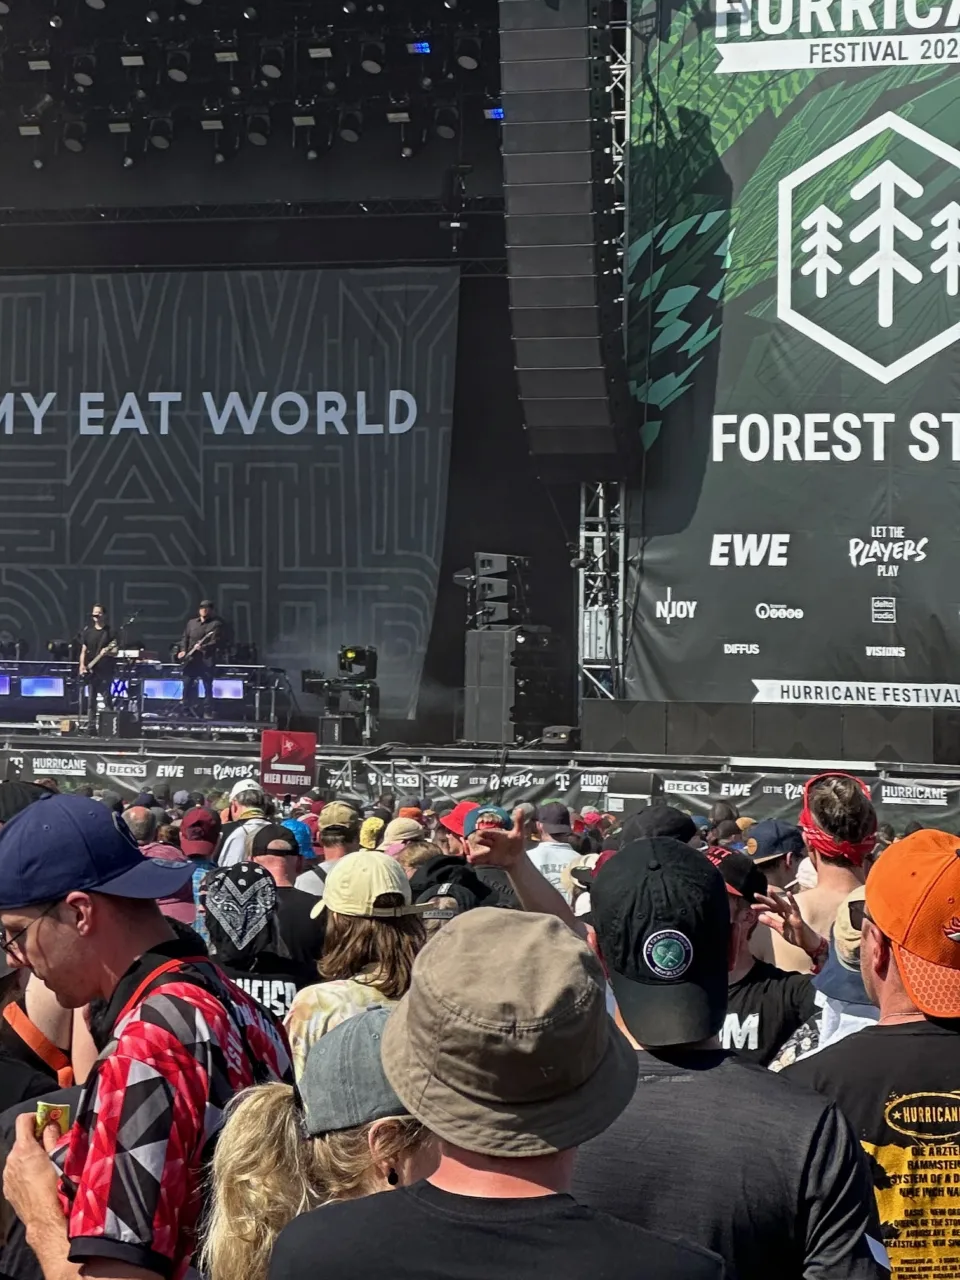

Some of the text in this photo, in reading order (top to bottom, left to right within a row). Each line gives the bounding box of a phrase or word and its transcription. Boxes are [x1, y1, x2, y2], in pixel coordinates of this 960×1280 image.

[809, 40, 909, 64] FESTIVAL
[78, 391, 183, 436] EAT
[202, 389, 418, 436] WORLD
[712, 412, 896, 462] FOREST
[871, 526, 906, 538] LET THE
[709, 533, 791, 567] EWE
[848, 537, 929, 567] PLAYERS
[877, 565, 899, 577] PLAY
[723, 643, 760, 655] DIFFUS
[865, 646, 906, 658] VISIONS
[780, 684, 877, 701] HURRICANE
[32, 757, 87, 770] HURRICANE
[156, 765, 184, 777] EWE
[213, 764, 254, 780] PLAYERS
[263, 773, 312, 786] HIER KAUFEN!
[720, 783, 752, 797] EWE
[881, 785, 948, 800] HURRICANE
